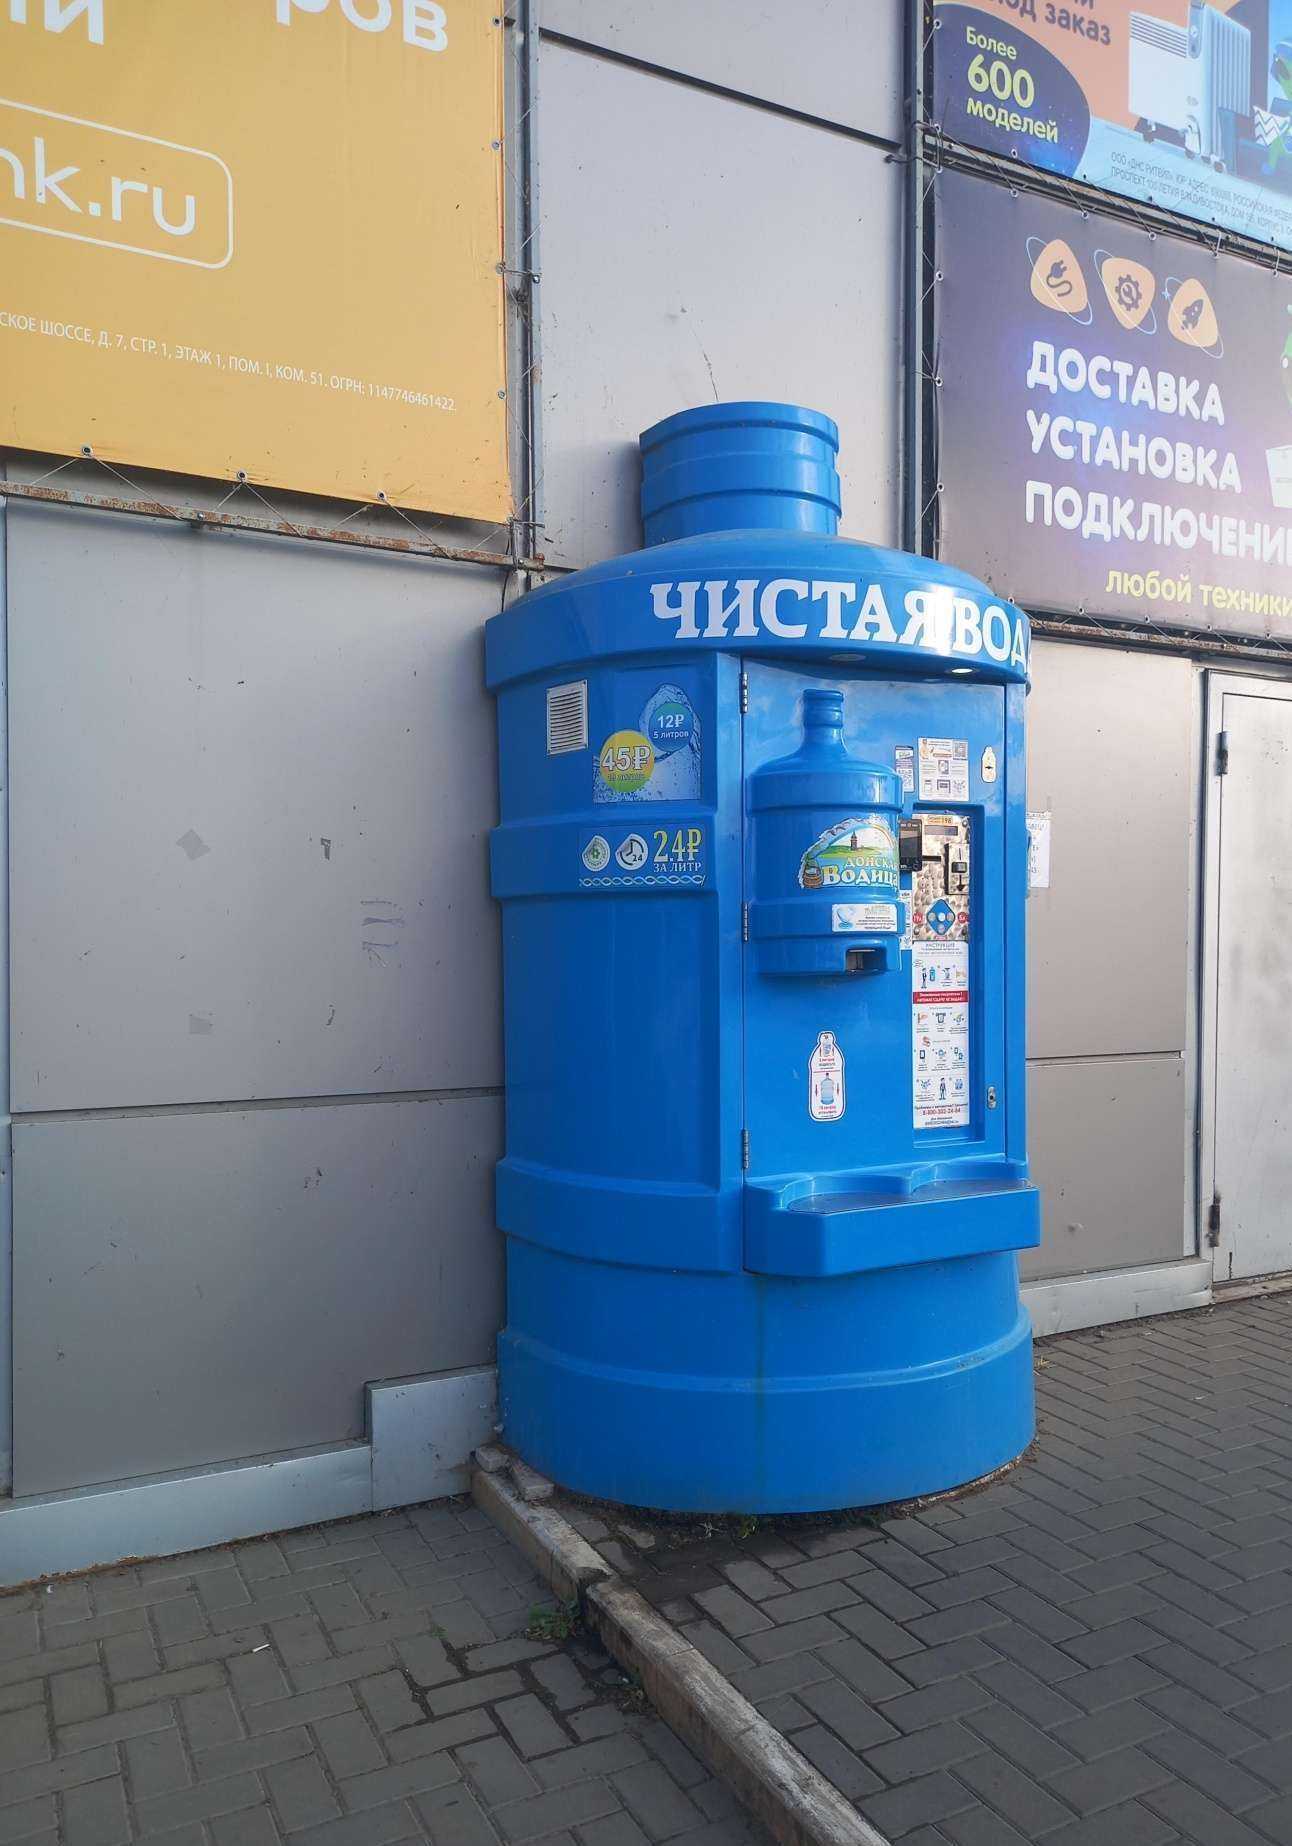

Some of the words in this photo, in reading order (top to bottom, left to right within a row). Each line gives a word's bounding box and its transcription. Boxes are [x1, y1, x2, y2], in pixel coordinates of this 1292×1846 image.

[966, 26, 1018, 60] Более
[1044, 2, 1112, 46] заказ
[966, 53, 1036, 109] 600
[966, 97, 1059, 144] моделей
[41, 319, 95, 345] ШОССЕ,
[98, 330, 113, 348] Д.
[115, 334, 127, 350] 7,
[130, 336, 158, 355] СТР.
[161, 343, 172, 359] 1,
[175, 345, 212, 365] ЭТАЖ
[215, 354, 226, 370] 1,
[229, 355, 263, 376] ПОМ.
[276, 365, 308, 383] КОМ.
[330, 375, 366, 395] ОГРН:
[1026, 340, 1225, 426] ДОСТАВКА
[1026, 409, 1242, 494] УСТАНОВКА
[1106, 569, 1192, 603] любой
[649, 578, 945, 646] ЧИСТАЯ
[951, 596, 1029, 673] ВОД
[653, 731, 659, 739] 5
[660, 730, 689, 740] литров
[653, 862, 668, 873] ЗА
[669, 862, 702, 872] ЛИТР
